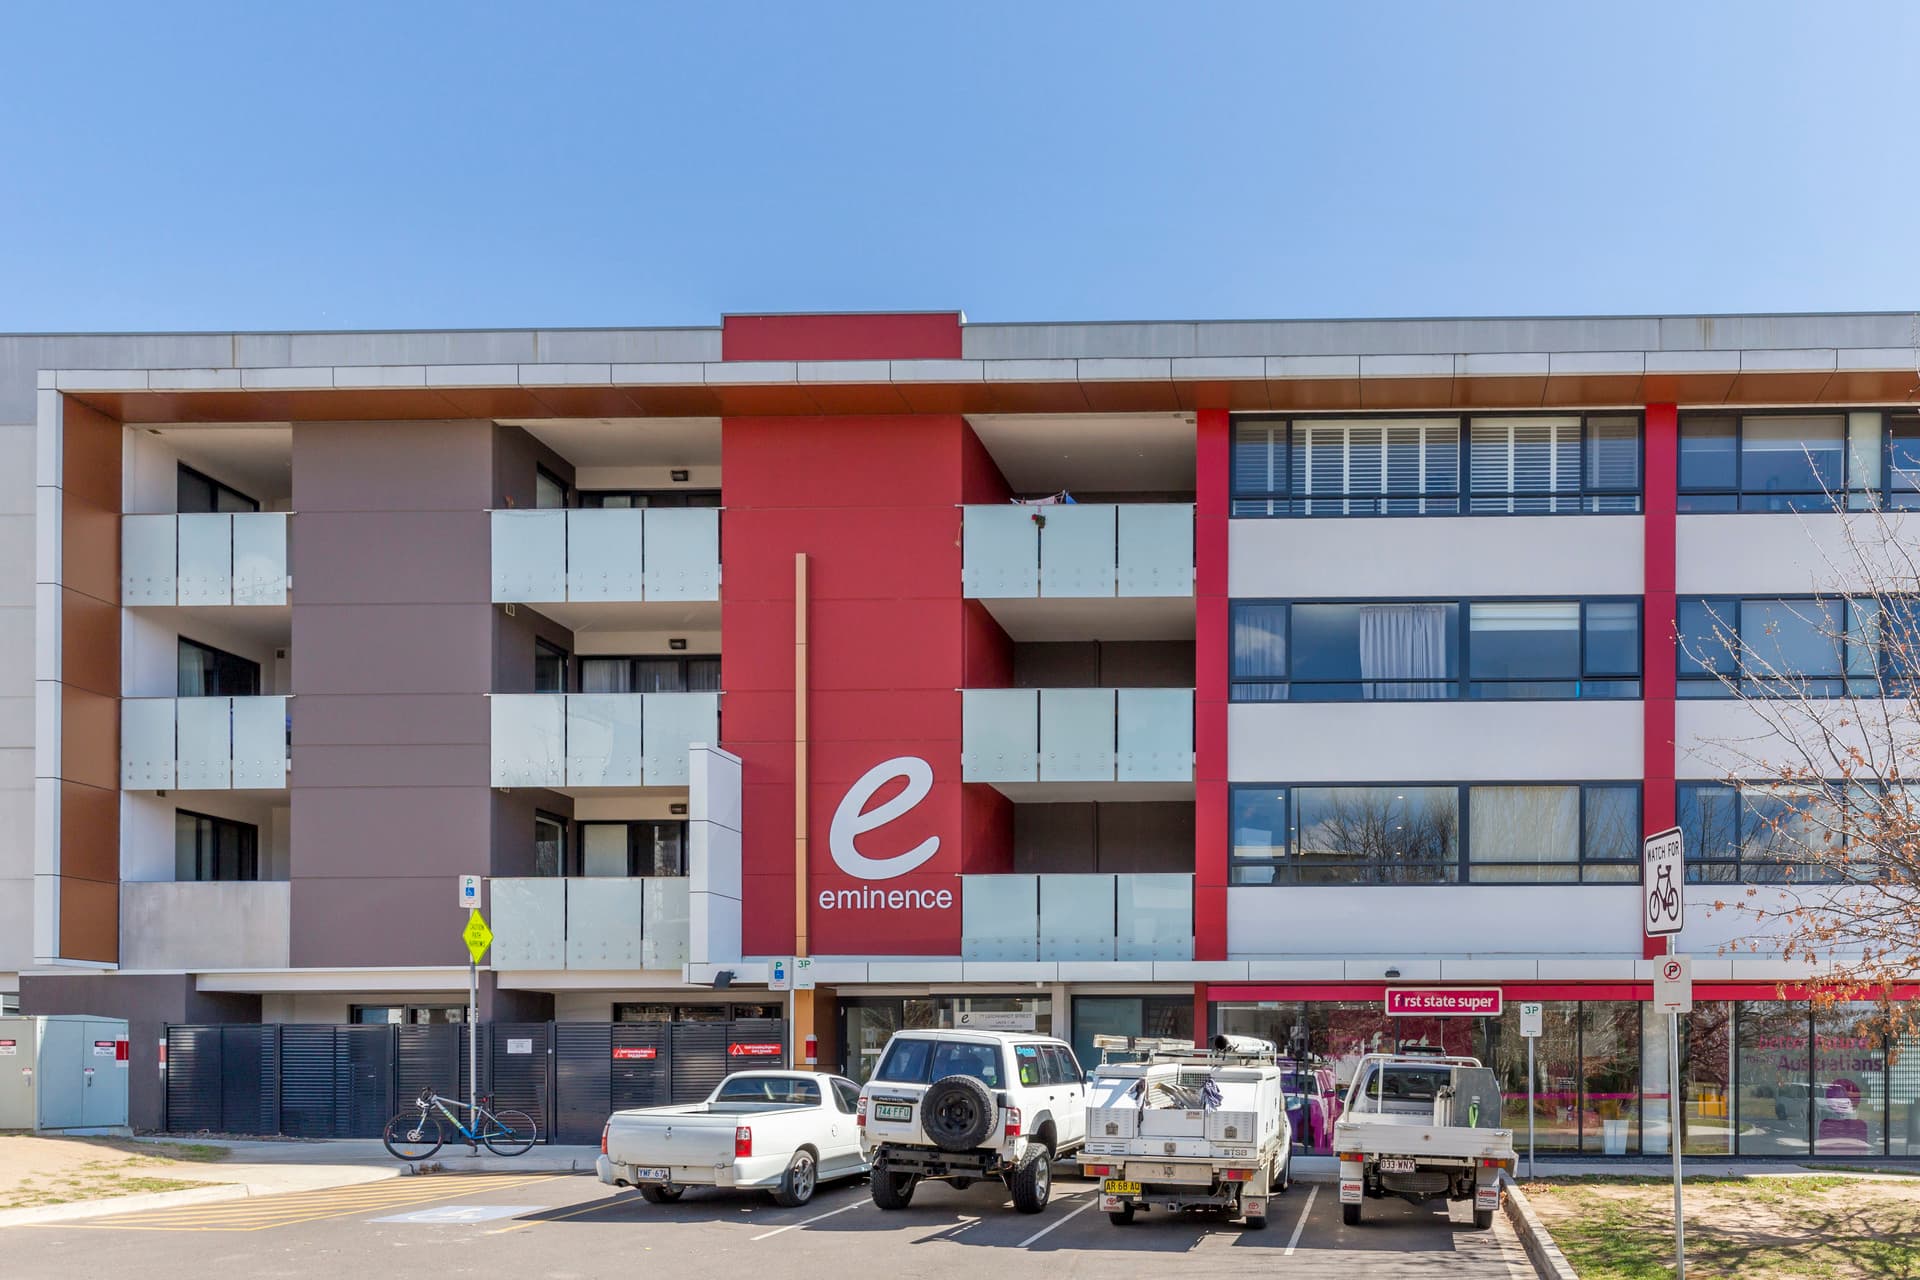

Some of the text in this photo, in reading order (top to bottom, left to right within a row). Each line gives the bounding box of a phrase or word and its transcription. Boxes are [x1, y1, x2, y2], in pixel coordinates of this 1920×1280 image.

[829, 756, 940, 880] e
[1647, 841, 1680, 862] WATCH FOR
[819, 885, 953, 909] eminence
[775, 961, 783, 970] P
[797, 959, 811, 968] 3P
[1424, 995, 1456, 1007] state
[1458, 997, 1494, 1011] super
[1524, 1006, 1539, 1015] 3P
